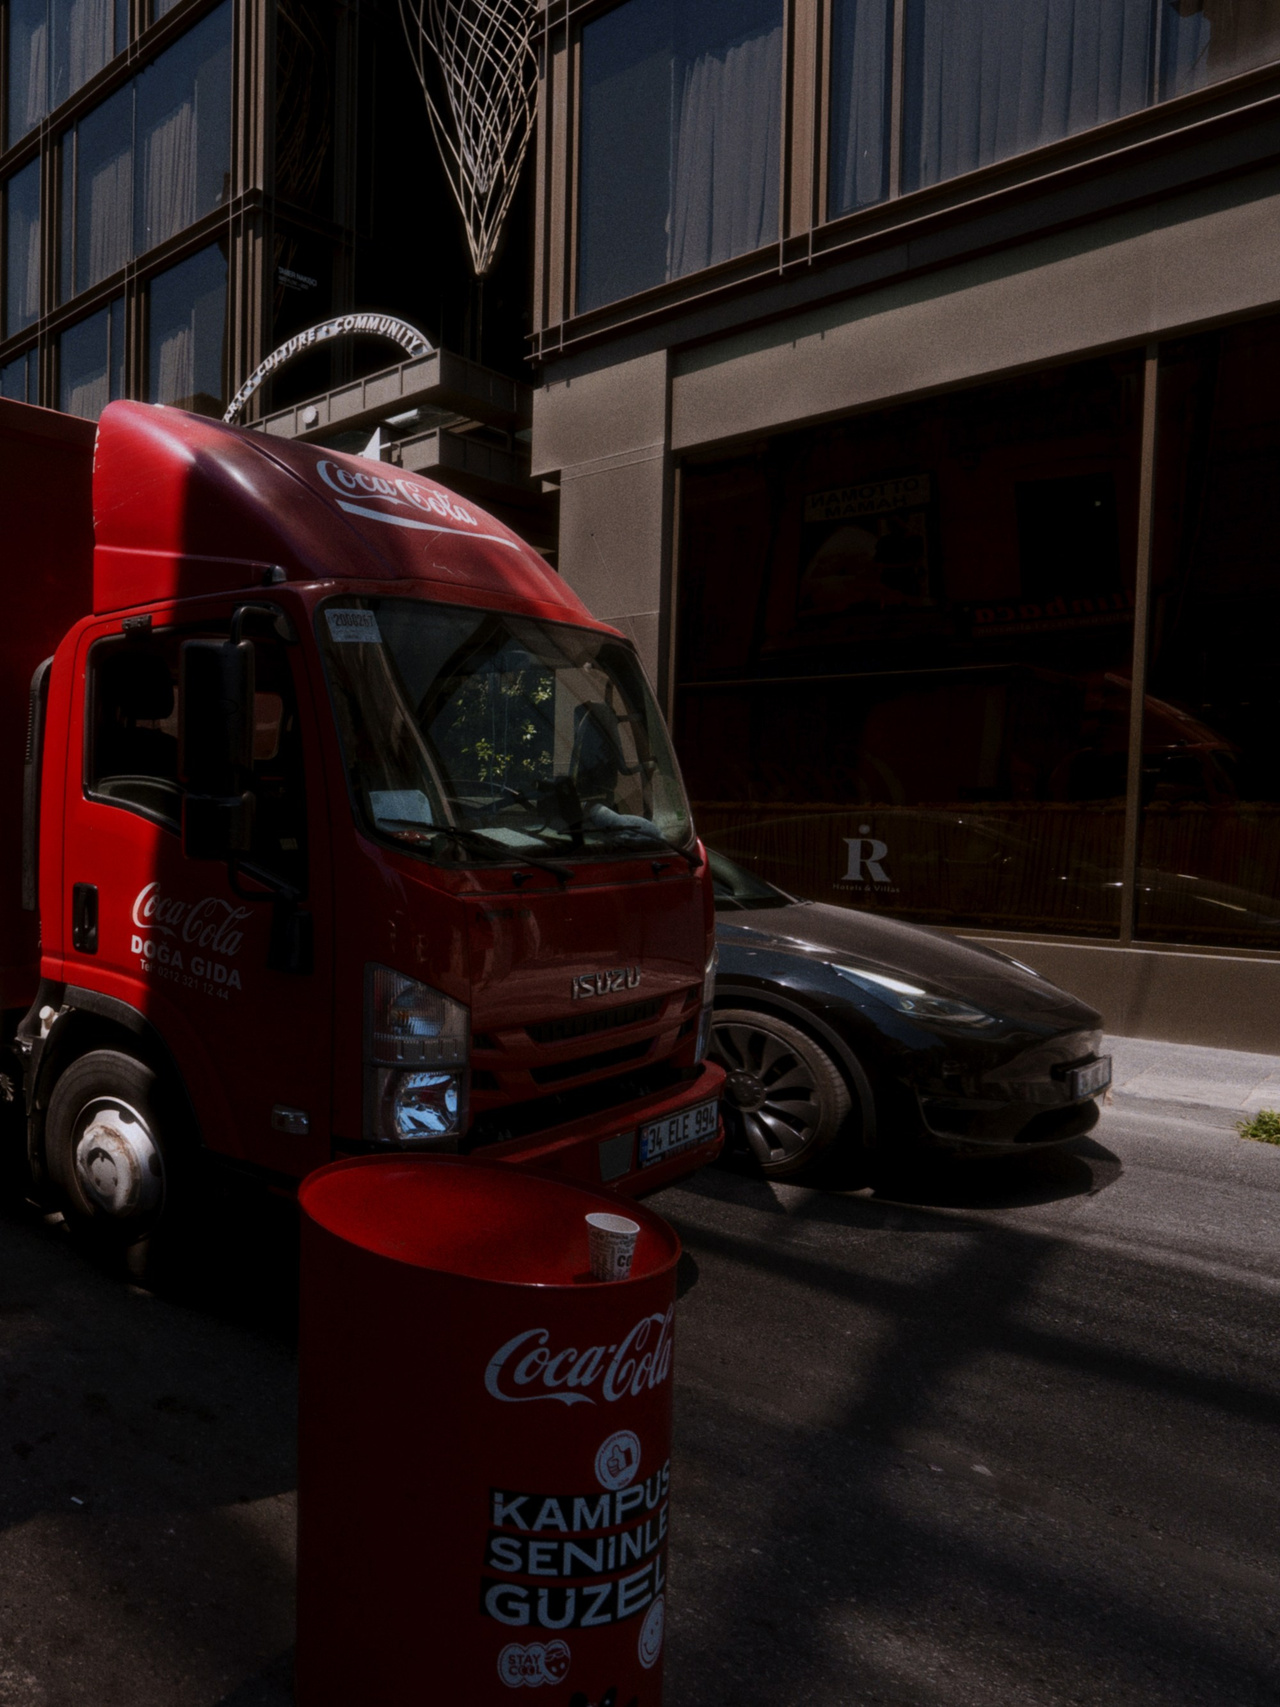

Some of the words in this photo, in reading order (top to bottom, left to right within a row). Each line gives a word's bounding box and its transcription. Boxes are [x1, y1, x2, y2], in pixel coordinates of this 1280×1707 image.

[257, 329, 317, 377] CULTURE
[334, 315, 422, 351] COMMUNITY
[315, 459, 478, 526] Coca-Cola
[132, 881, 255, 956] Coca-Cola
[130, 934, 184, 971] DOĞA
[190, 955, 243, 991] GIDA
[157, 966, 180, 983] 0212
[202, 982, 214, 996] 12
[216, 988, 230, 1001] 44
[572, 964, 641, 1000] ISUZU
[647, 1125, 663, 1154] 34
[668, 1114, 690, 1146] ELE
[694, 1105, 716, 1135] 994
[484, 1302, 674, 1407] Coca-Cola
[507, 1653, 542, 1664] STAY
[508, 1664, 543, 1676] COOL
